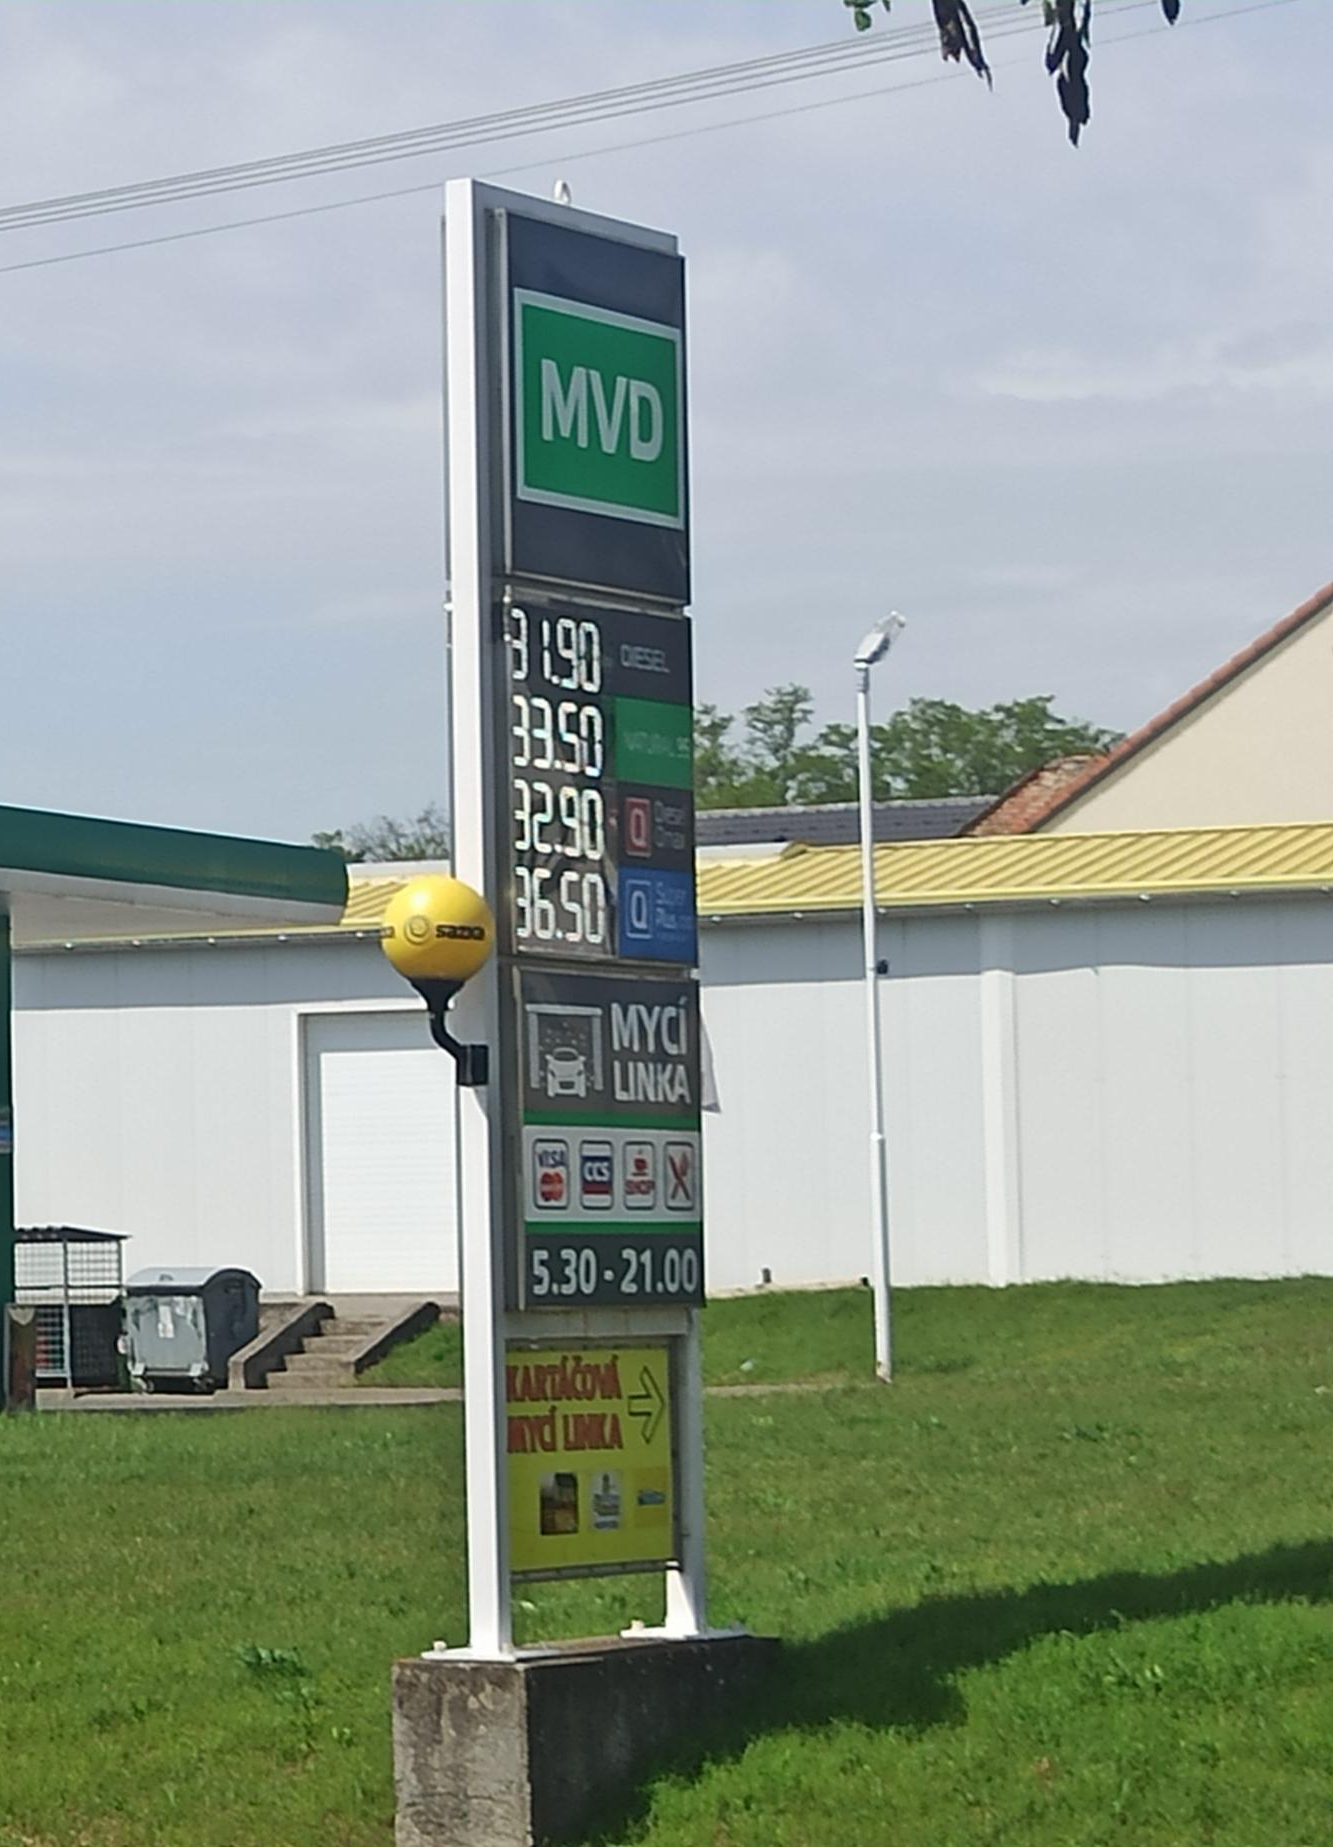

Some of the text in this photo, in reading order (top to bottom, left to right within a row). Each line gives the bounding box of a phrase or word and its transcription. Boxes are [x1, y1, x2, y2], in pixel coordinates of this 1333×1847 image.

[541, 358, 664, 462] MVD
[509, 607, 602, 693] 31.90
[511, 694, 603, 778] 33.50
[513, 779, 605, 861] 32.90
[514, 866, 606, 944] 36.50
[611, 995, 689, 1055] MYCÍ
[612, 1060, 692, 1104] LINKA
[537, 1149, 567, 1168] VISA
[583, 1161, 610, 1182] CCS
[624, 1179, 656, 1197] SHOP
[533, 1248, 598, 1295] 5.30
[620, 1248, 698, 1294] 21.00
[562, 1413, 624, 1451] LINKA
